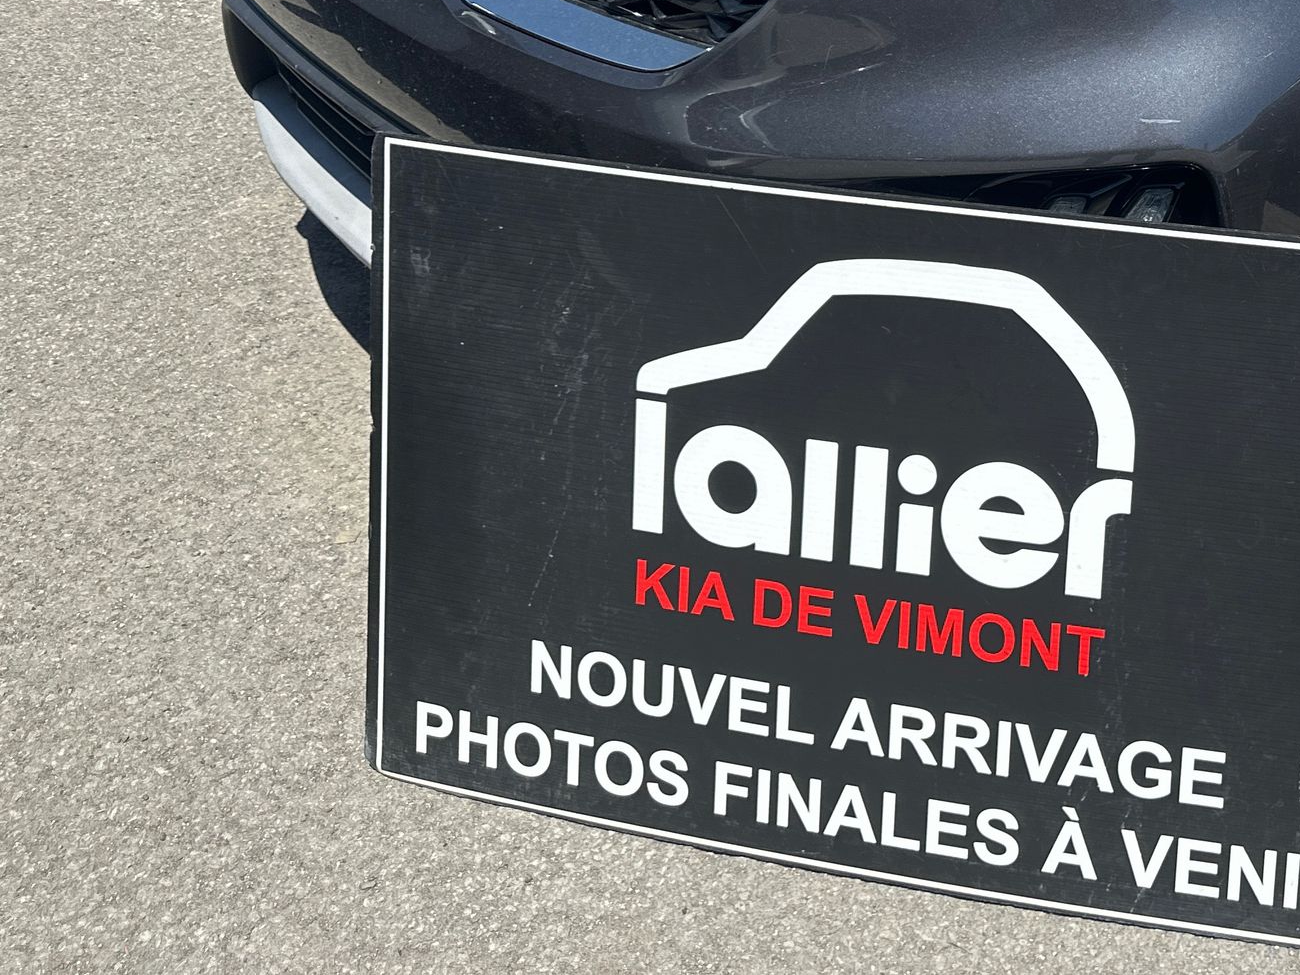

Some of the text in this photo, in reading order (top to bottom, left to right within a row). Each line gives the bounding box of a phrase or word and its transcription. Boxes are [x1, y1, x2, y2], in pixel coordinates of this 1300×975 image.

[635, 558, 1106, 677] KIA DE VIMONT
[415, 700, 689, 807] PHOTOS
[713, 760, 1020, 867] FINALES
[1040, 805, 1098, 881] À
[530, 639, 1227, 810] NOUVEL ARRIVAGE
